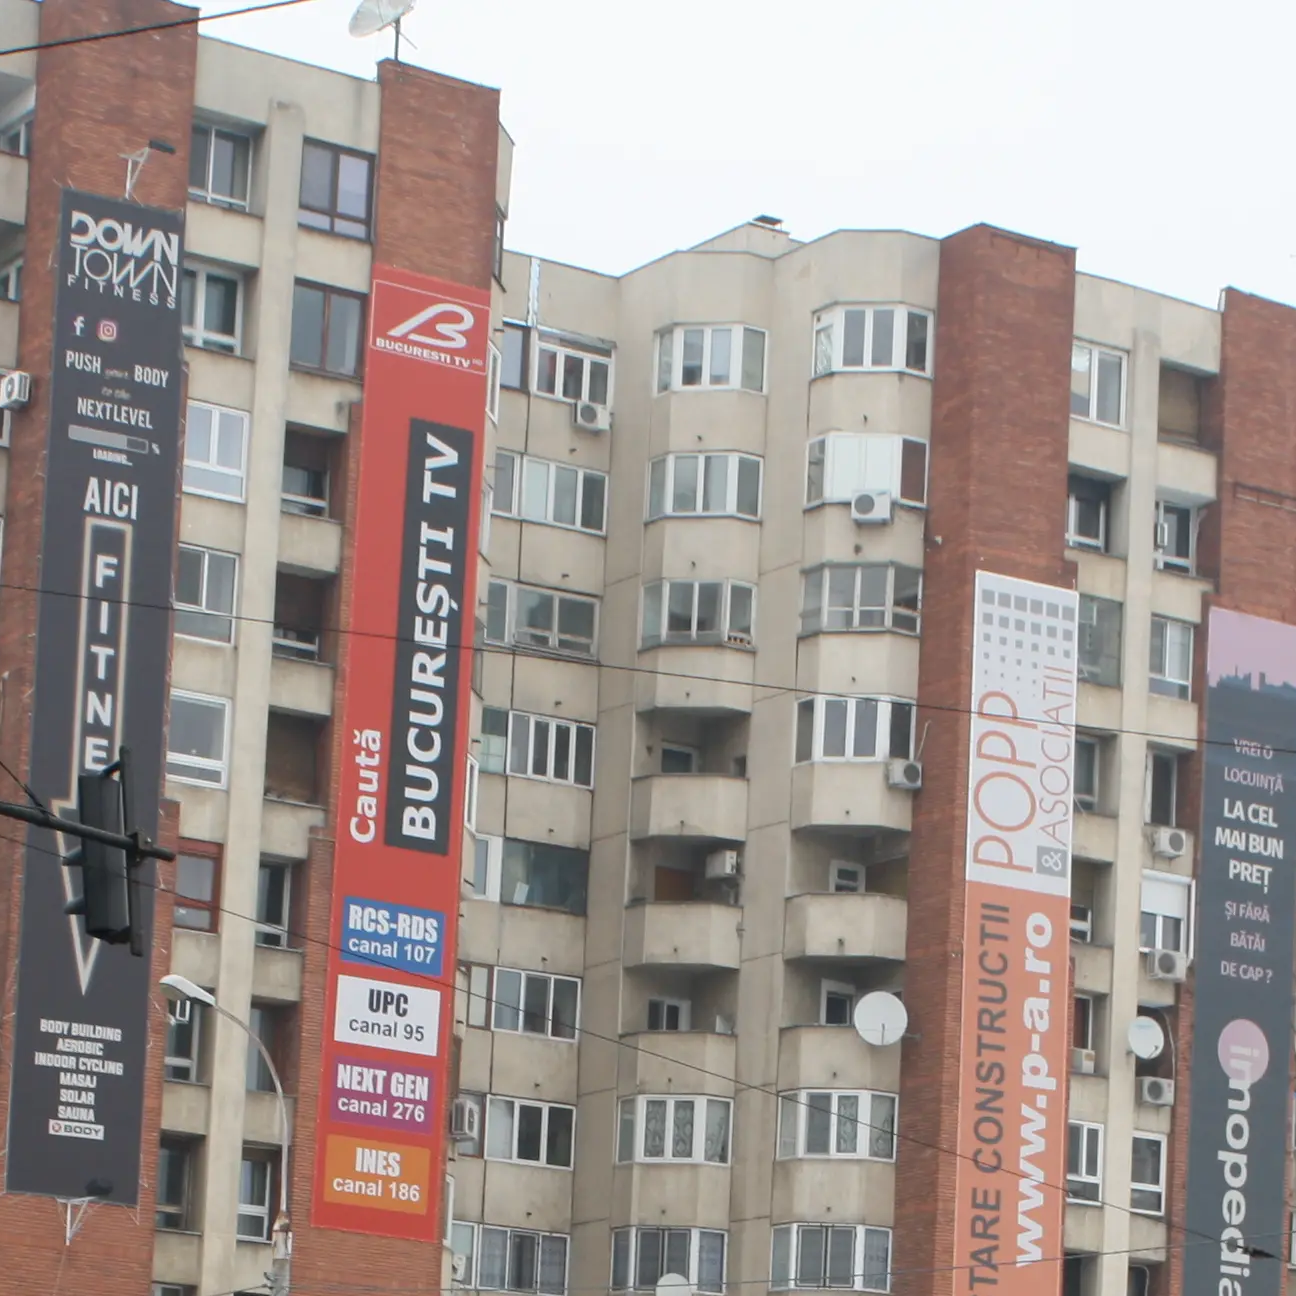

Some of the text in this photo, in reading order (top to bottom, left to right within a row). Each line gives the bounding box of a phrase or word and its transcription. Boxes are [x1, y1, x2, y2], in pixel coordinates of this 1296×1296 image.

[70, 210, 179, 266] DOWN
[69, 241, 177, 298] TOWN
[67, 274, 177, 310] FITNESS
[65, 350, 102, 375] PUSH
[134, 364, 170, 388] BODY
[375, 337, 451, 365] BUCURESTI
[453, 356, 471, 369] TV
[83, 476, 139, 521] AICI
[402, 432, 461, 842] BUCUREȘTI TV
[84, 553, 120, 772] FITNE
[349, 727, 382, 844] Caută
[972, 690, 1038, 875] POPP
[1223, 798, 1278, 828] LA CEL
[1215, 826, 1284, 859] MAI BUN
[1228, 859, 1273, 895] PREȚ
[348, 903, 439, 944] RCS-RDS
[348, 937, 436, 965] canal 107
[1220, 960, 1237, 978] DE
[1239, 964, 1264, 982] CAP
[368, 988, 409, 1018] UPC
[40, 1018, 122, 1042] BODY BUILDING
[349, 1018, 425, 1043] canal 95
[970, 902, 1010, 1175] CONSTRUCTII
[56, 1037, 104, 1056] AEROBIC
[34, 1051, 124, 1076] INDOOR CYCLING
[59, 1072, 97, 1089] MASAJ
[59, 1088, 95, 1105] SOLAR
[336, 1063, 430, 1102] NEXT GEN
[1015, 911, 1058, 1269] www.p-a.ro
[57, 1105, 96, 1123] SAUNA
[337, 1097, 425, 1123] canal 276
[63, 1125, 101, 1136] BODY
[355, 1147, 401, 1178] INES
[332, 1177, 421, 1203] canal 186
